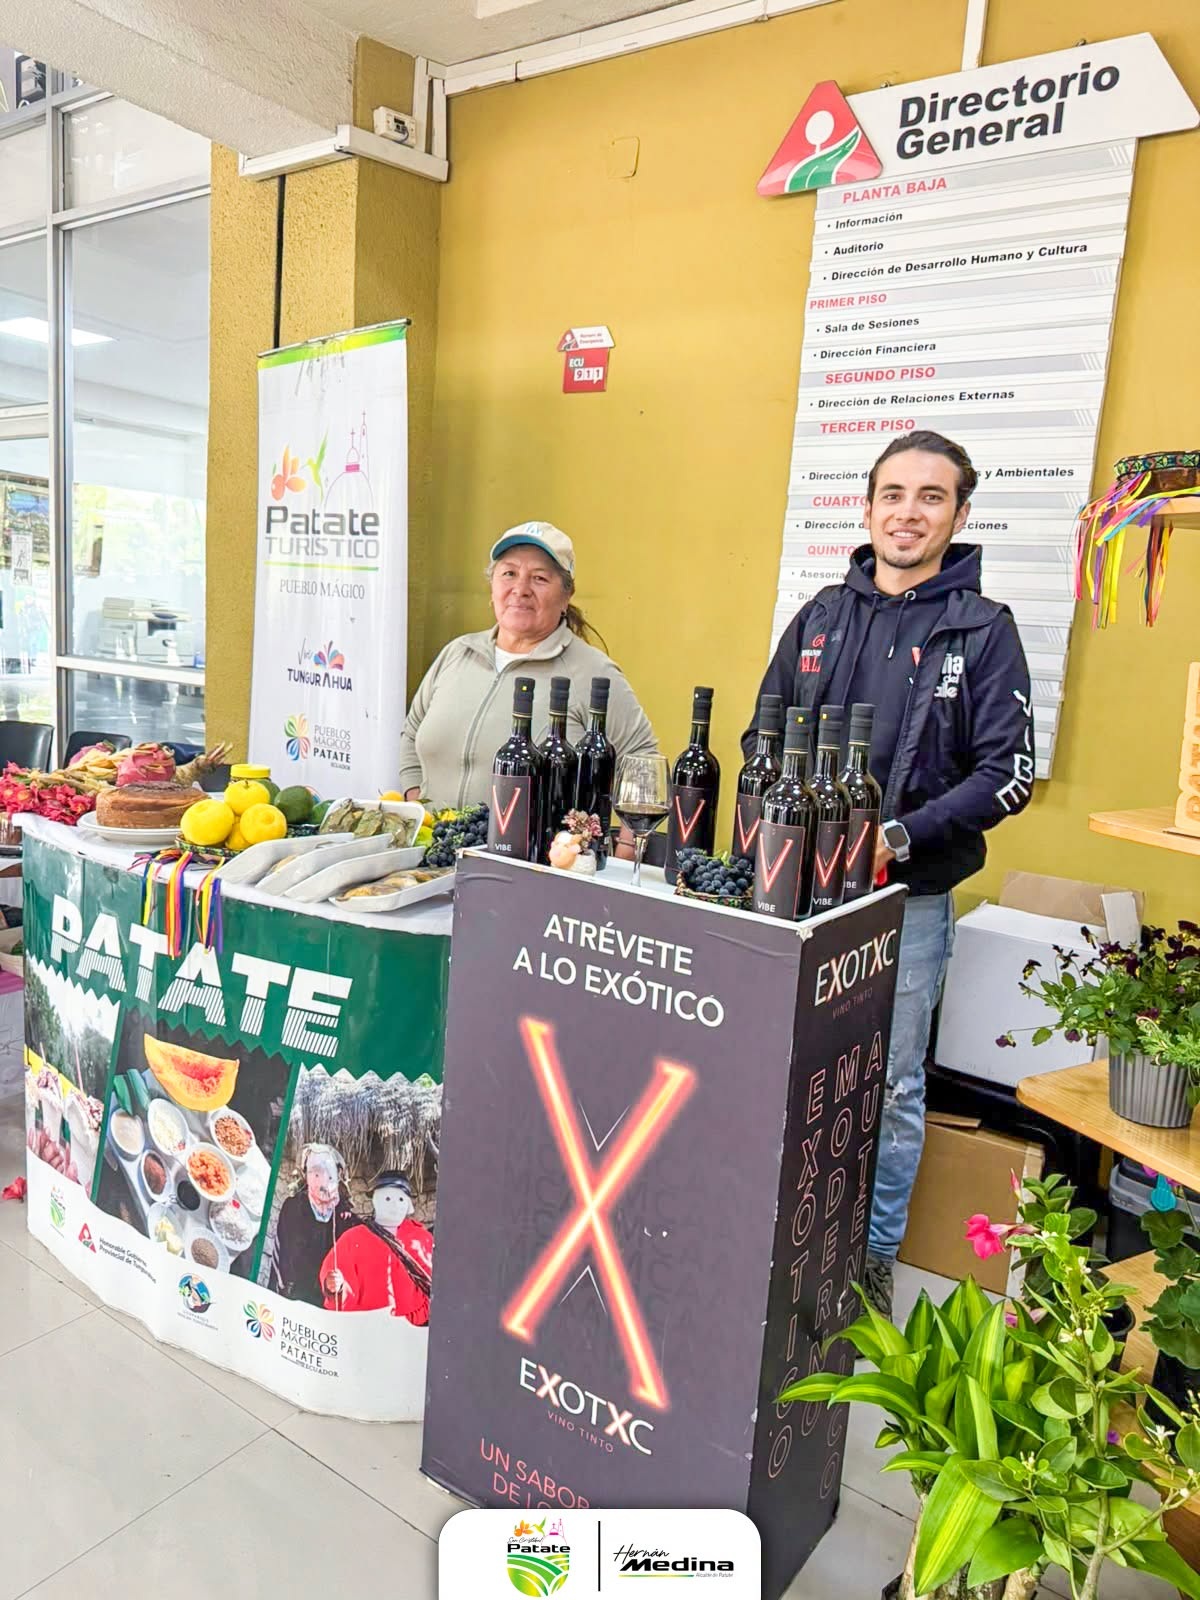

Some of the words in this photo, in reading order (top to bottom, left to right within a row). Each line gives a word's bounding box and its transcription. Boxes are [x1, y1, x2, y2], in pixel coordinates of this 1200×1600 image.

[900, 62, 1120, 128] Directorio
[896, 102, 1064, 159] General
[842, 184, 901, 204] PLANTA
[906, 177, 947, 194] BAJA
[835, 212, 903, 229] Información
[833, 241, 884, 256] Auditorio
[831, 267, 884, 281] Dirección
[887, 265, 901, 275] de
[905, 257, 967, 272] Desarrollo
[970, 251, 1023, 265] Humano
[1026, 250, 1034, 261] y
[1038, 244, 1087, 257] Cultura
[809, 296, 855, 309] PRIMER
[858, 293, 887, 305] PISO
[825, 324, 848, 334] Sala
[851, 322, 865, 332] de
[868, 317, 920, 330] Sesiones
[820, 346, 872, 359] Dirección
[875, 342, 937, 355] Financiera
[576, 368, 602, 379] 911
[825, 370, 896, 385] SEGUNDO
[900, 366, 936, 380] PISO
[818, 395, 870, 408] Dirección
[873, 395, 887, 405] de
[890, 392, 955, 405] Relaciones
[959, 390, 1015, 401] Externas
[820, 420, 876, 433] TERCER
[880, 418, 915, 431] PISO
[809, 471, 858, 480] Dirección
[985, 470, 992, 479] y
[995, 467, 1075, 477] Ambientales
[266, 506, 380, 536] Patate
[805, 520, 855, 529] Dirección
[280, 579, 317, 596] PUEBLO
[320, 578, 365, 599] MÁGICO
[287, 668, 352, 691] TUNGURAHUA
[314, 725, 351, 741] PUEBLOS
[313, 748, 351, 763] PATATE
[996, 690, 1034, 811] VIBE
[495, 843, 512, 851] VIBE
[757, 901, 776, 912] VIBE
[813, 898, 832, 906] VIBE
[543, 914, 694, 976] ATRÉVETE
[51, 894, 353, 1058] PATATE
[815, 929, 897, 1007] EXOTXC
[512, 946, 533, 975] A
[540, 952, 577, 985] LO
[585, 970, 725, 1028] EXÓTICO
[280, 1327, 338, 1357] MÁGICOS
[282, 1316, 338, 1346] PUEBLOS
[280, 1341, 322, 1368] PATATE
[305, 1363, 339, 1378] ECUADOR
[519, 1357, 654, 1455] EXOTXC
[547, 1410, 575, 1432] VINO
[579, 1427, 614, 1453] TINTO
[479, 1437, 510, 1472] UN
[493, 1472, 521, 1505] DE
